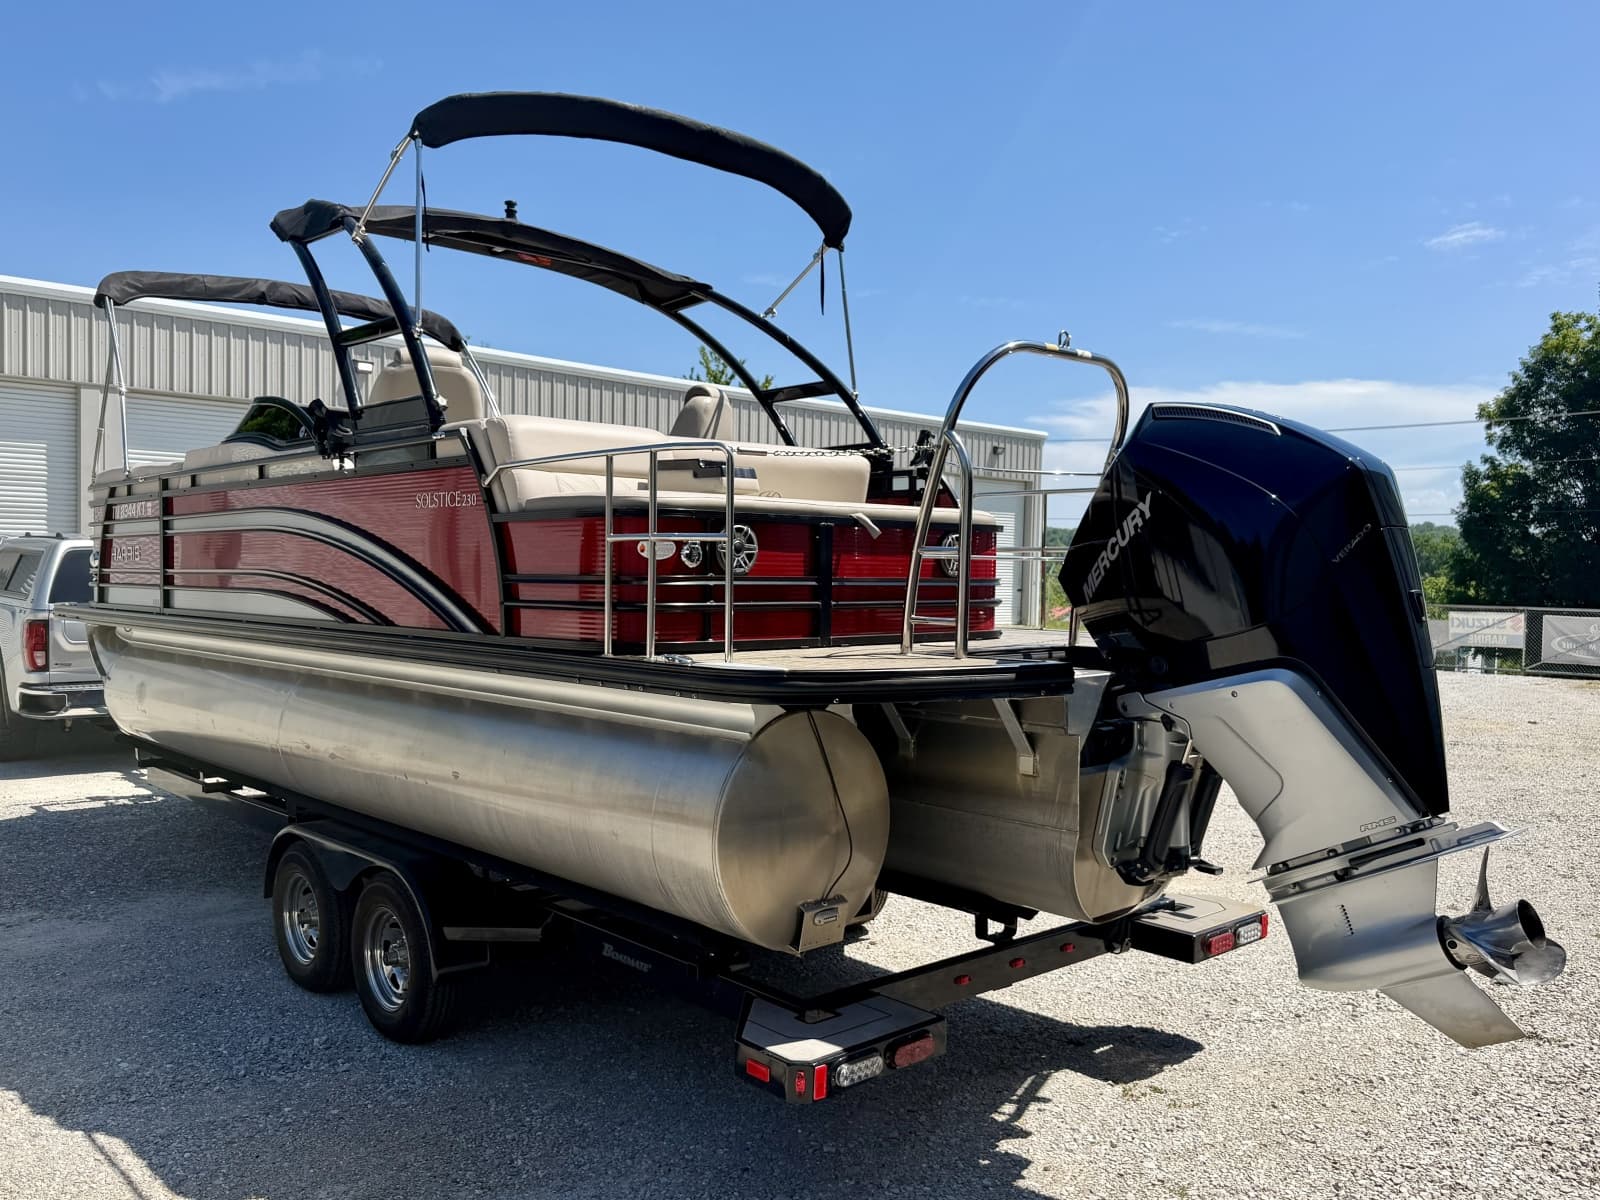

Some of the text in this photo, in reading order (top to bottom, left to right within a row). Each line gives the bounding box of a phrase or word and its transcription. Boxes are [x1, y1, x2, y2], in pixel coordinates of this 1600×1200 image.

[415, 491, 477, 509] SOLSTICE 230
[1082, 490, 1152, 604] MERCURY
[1331, 523, 1372, 563] VERADO
